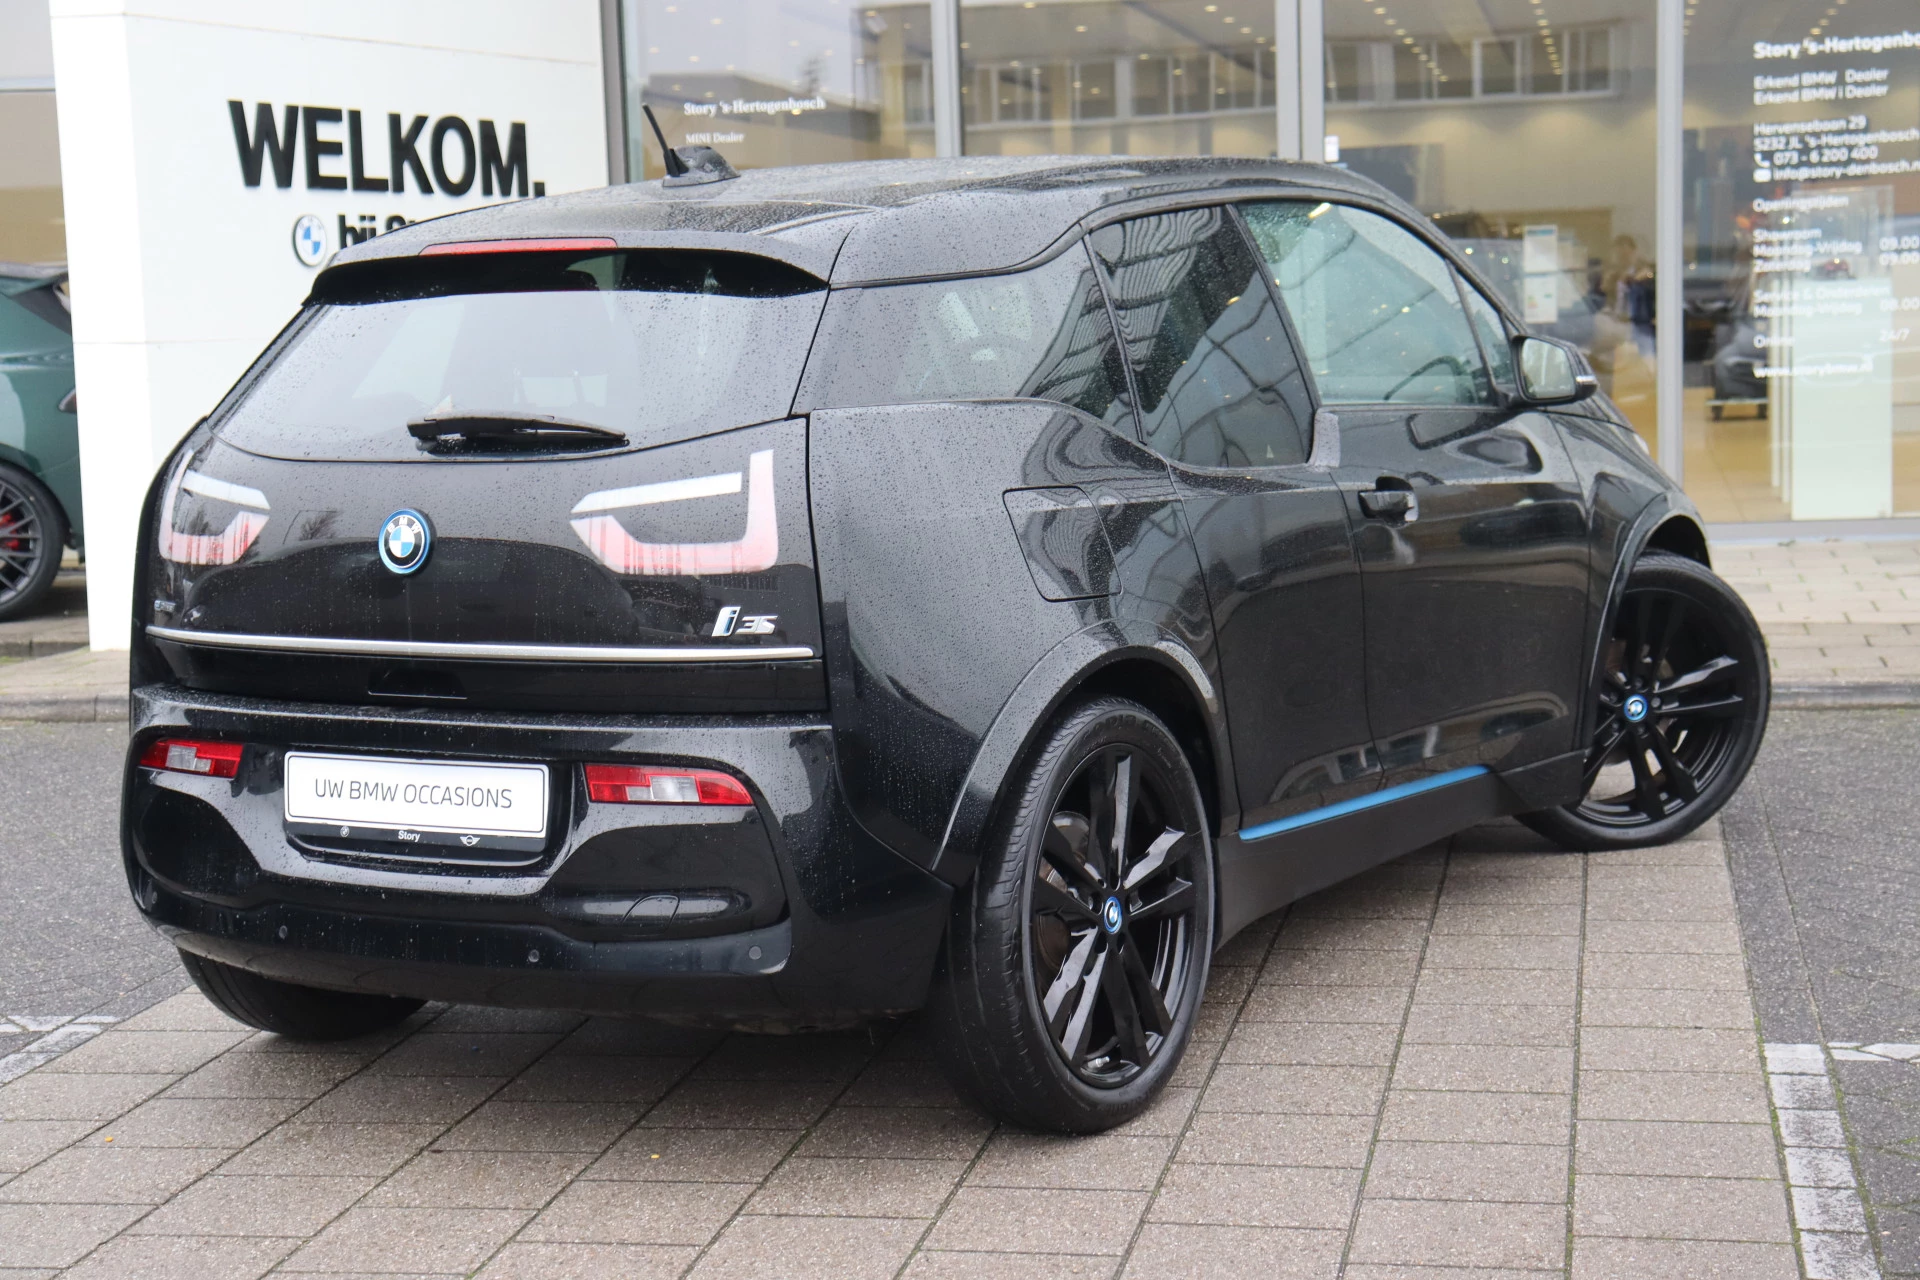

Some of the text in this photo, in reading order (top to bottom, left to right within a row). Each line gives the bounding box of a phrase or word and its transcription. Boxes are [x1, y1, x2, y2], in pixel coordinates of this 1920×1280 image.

[1753, 41, 1800, 58] Story
[1801, 70, 1837, 86] BMW
[1845, 68, 1889, 84] Dealer
[1801, 86, 1837, 102] BMW
[1845, 84, 1889, 99] Dealer
[683, 102, 718, 118] Story
[685, 131, 744, 145] MINI Dealer
[228, 99, 546, 199] WELKOM.
[1773, 150, 1799, 166] 073
[1850, 144, 1878, 160] 400
[315, 778, 513, 809] UW BMW OCCASIONS
[398, 829, 420, 842] Story
